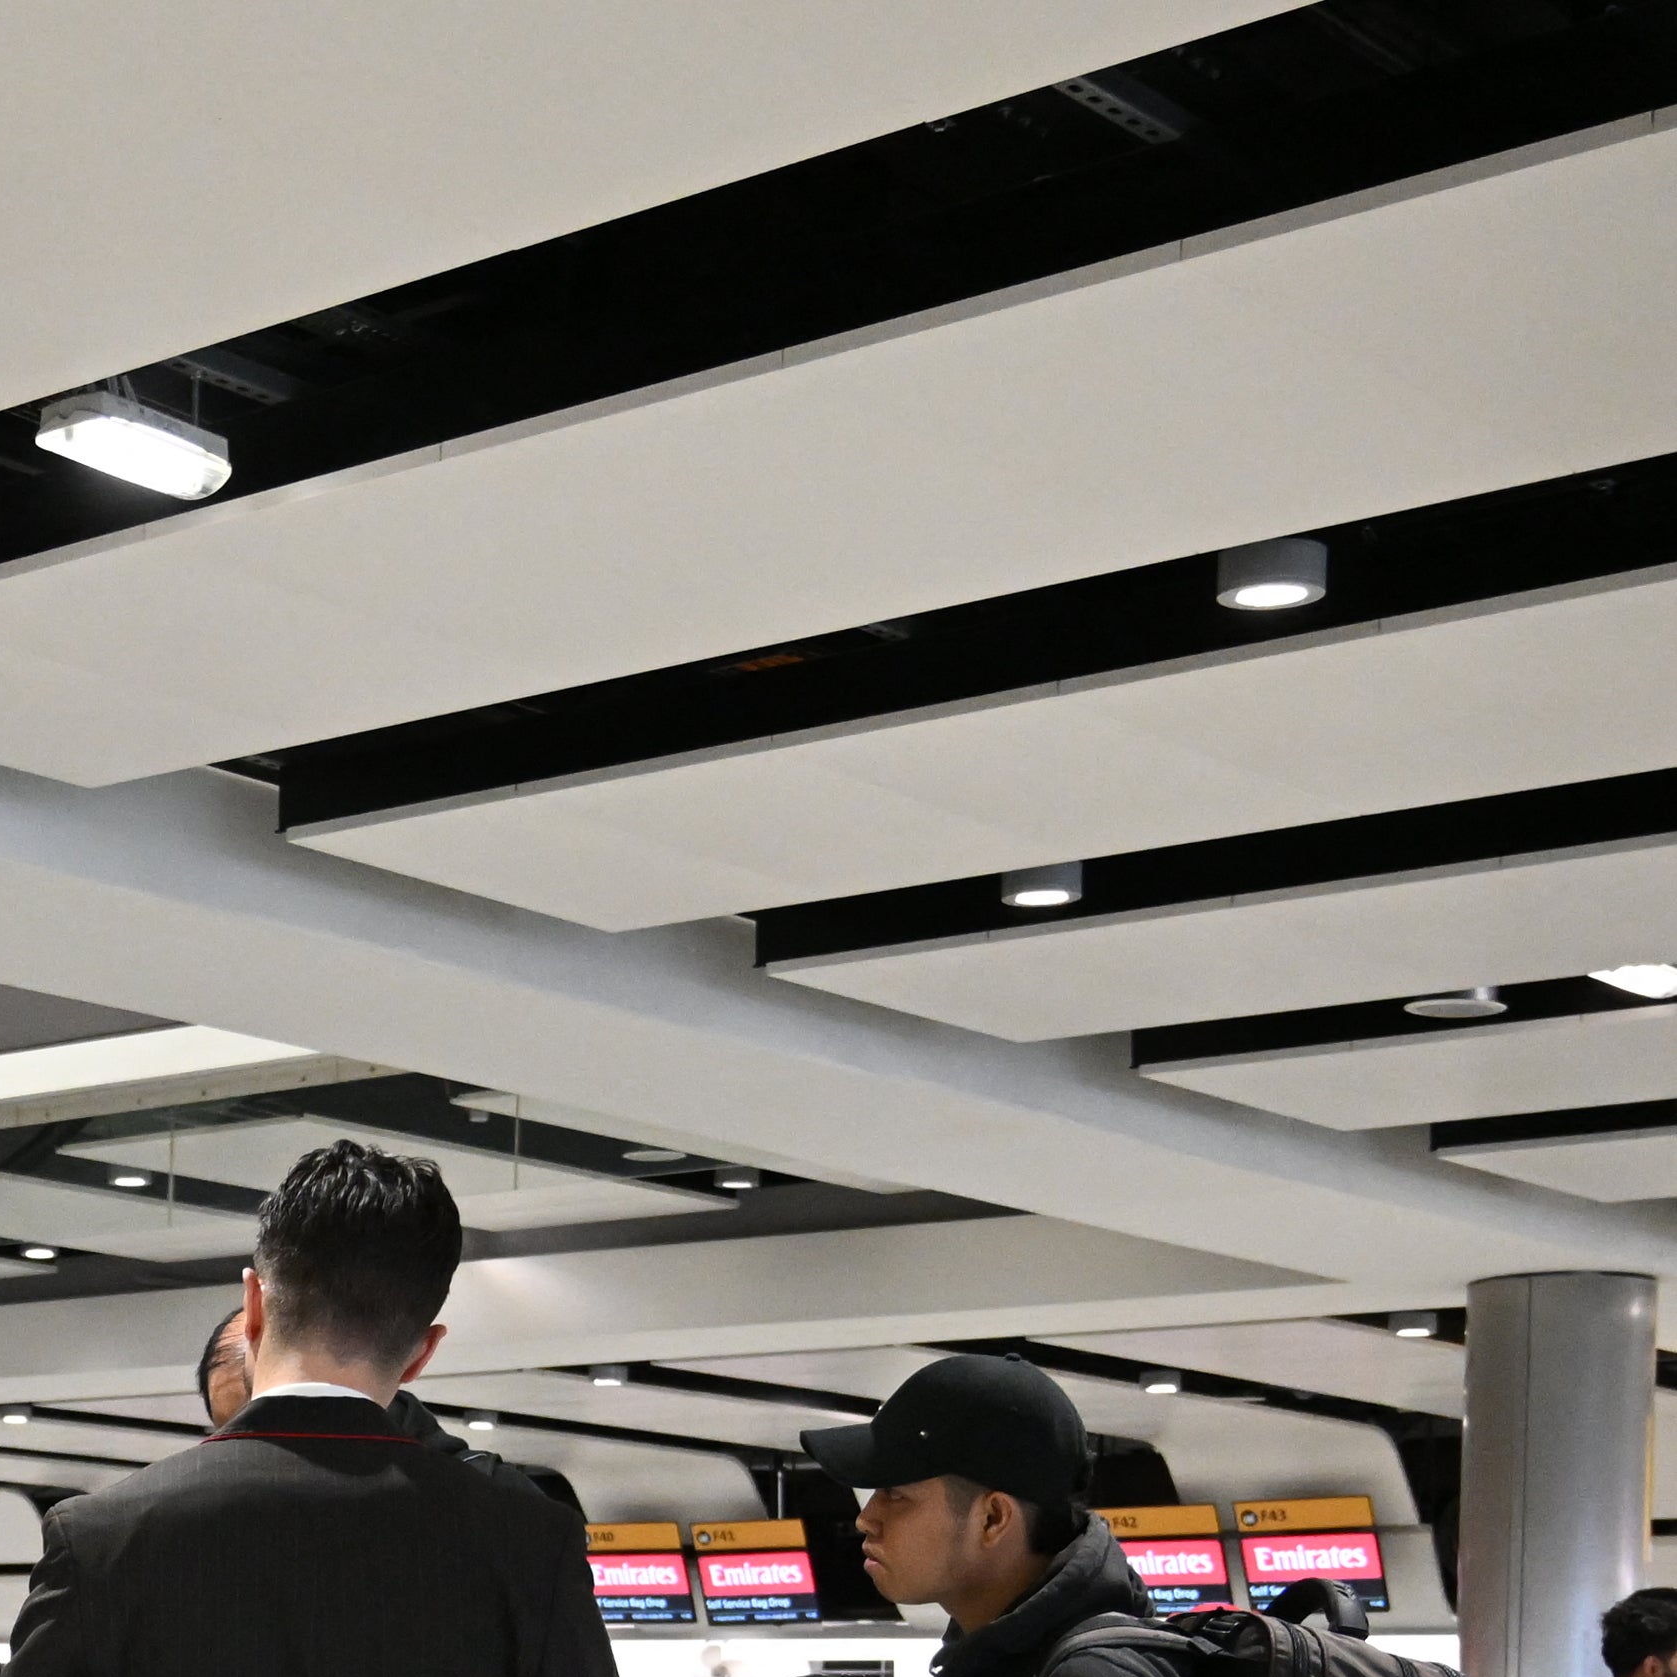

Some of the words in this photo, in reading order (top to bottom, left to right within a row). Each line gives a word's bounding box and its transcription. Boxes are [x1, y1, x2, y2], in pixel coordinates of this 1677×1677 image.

[1111, 1516, 1137, 1529] F42
[1260, 1509, 1286, 1522] F43
[1127, 1550, 1214, 1575] mirates
[1254, 1544, 1367, 1571] Emirates
[592, 1563, 679, 1586] Emirates
[709, 1562, 803, 1587] Emirates
